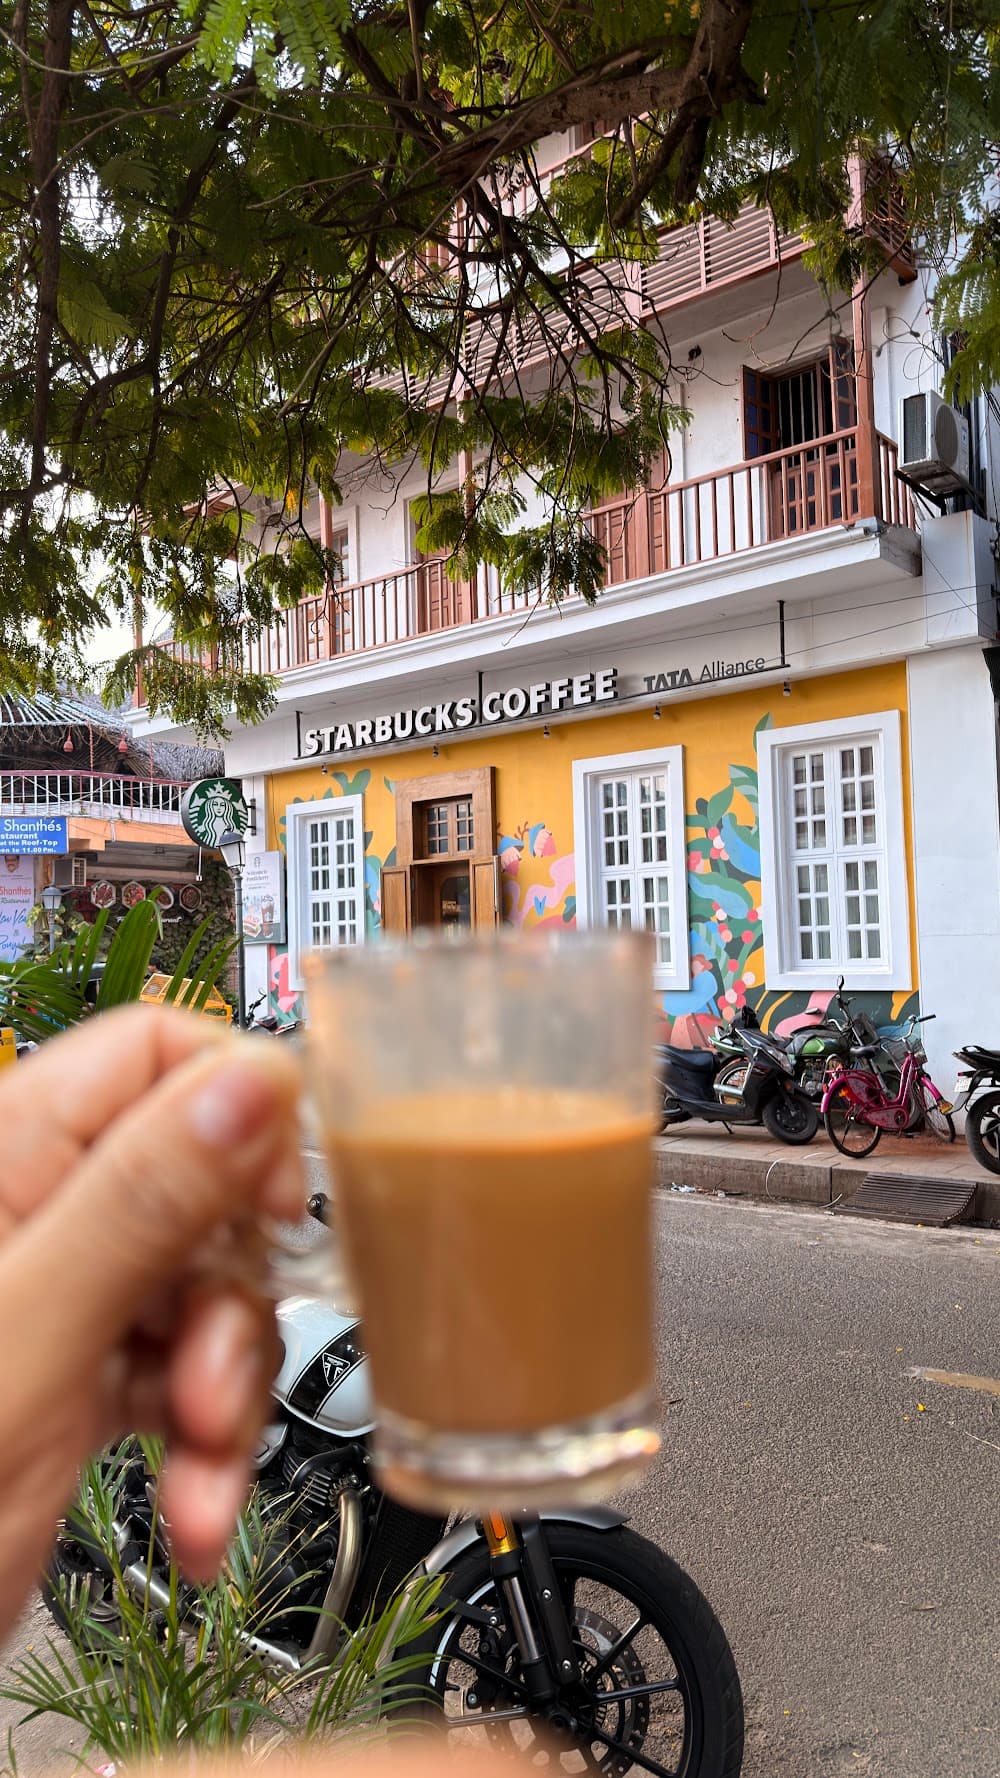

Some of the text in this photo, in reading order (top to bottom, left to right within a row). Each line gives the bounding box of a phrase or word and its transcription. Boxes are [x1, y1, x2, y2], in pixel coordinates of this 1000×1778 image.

[643, 657, 766, 692] TATA Alliance
[303, 668, 618, 756] STARBUCKS COFFEE
[4, 819, 62, 832] Shanthés
